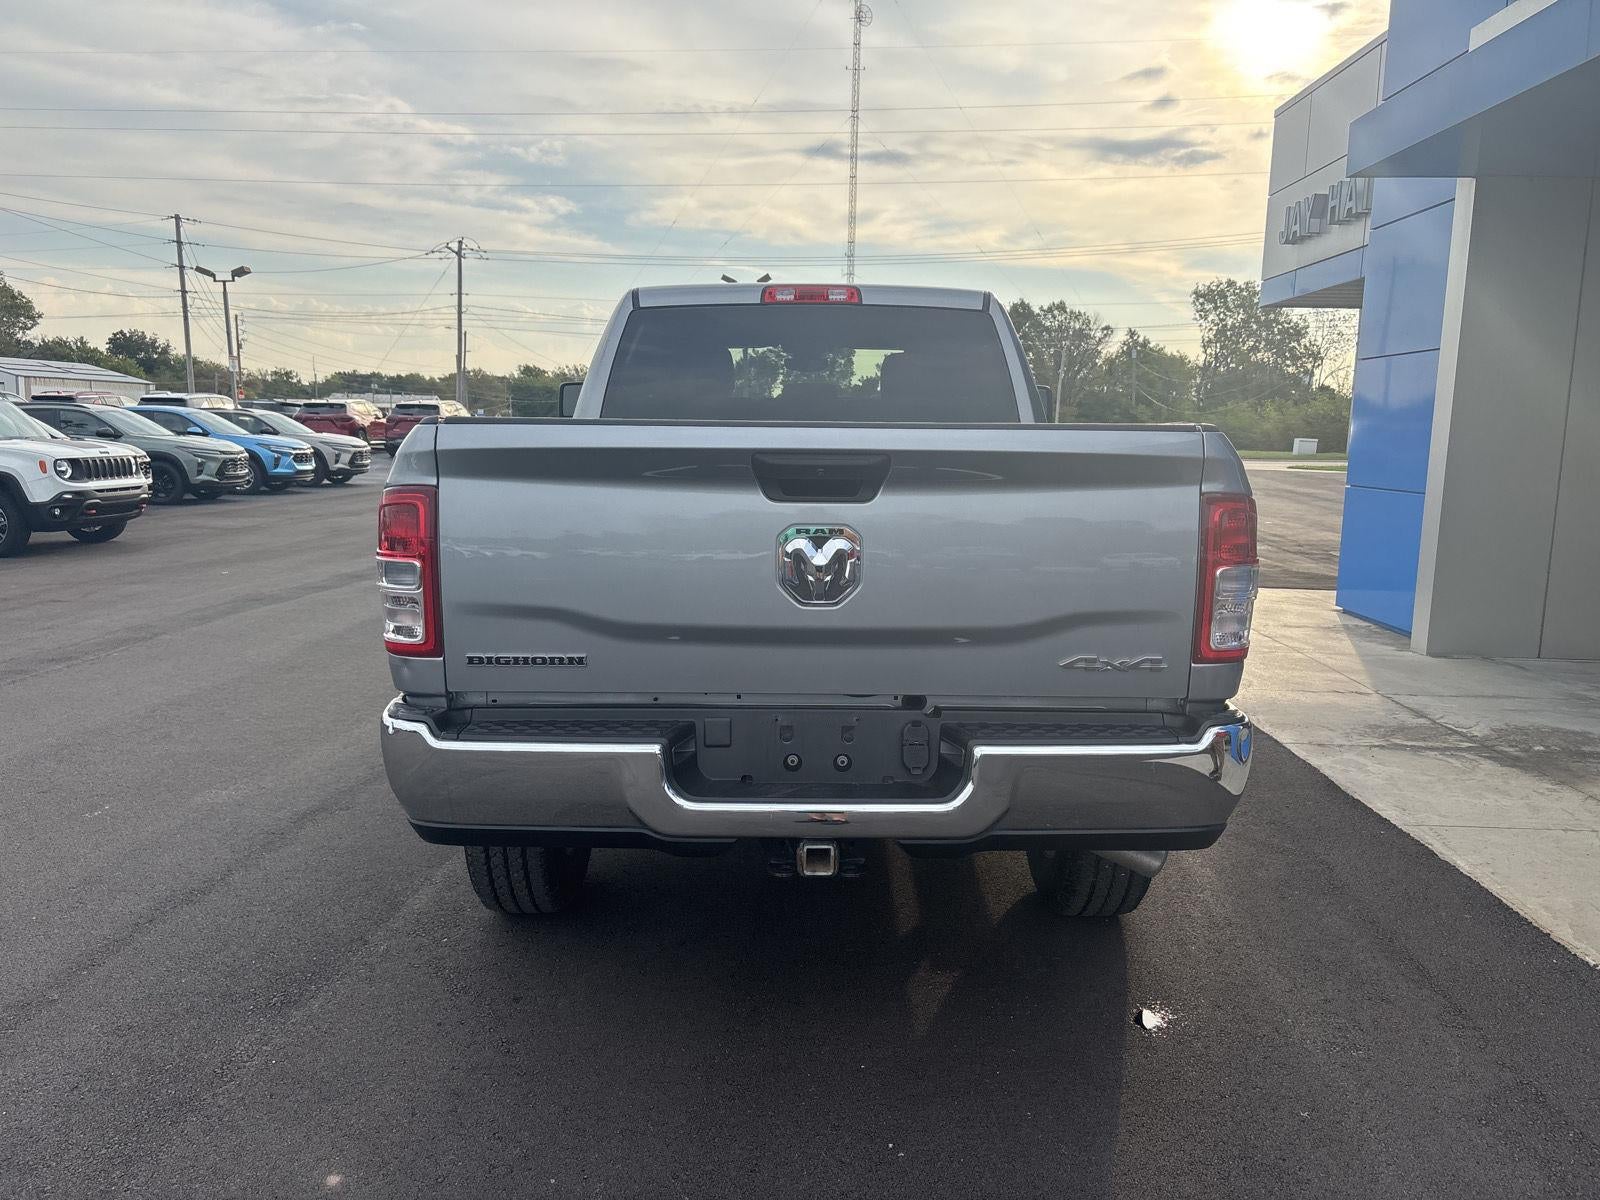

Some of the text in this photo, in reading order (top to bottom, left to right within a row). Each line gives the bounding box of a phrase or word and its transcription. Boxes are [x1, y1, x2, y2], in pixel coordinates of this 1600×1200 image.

[1279, 194, 1321, 245] JAY
[795, 527, 845, 535] RAM
[466, 654, 587, 666] BIGHORN
